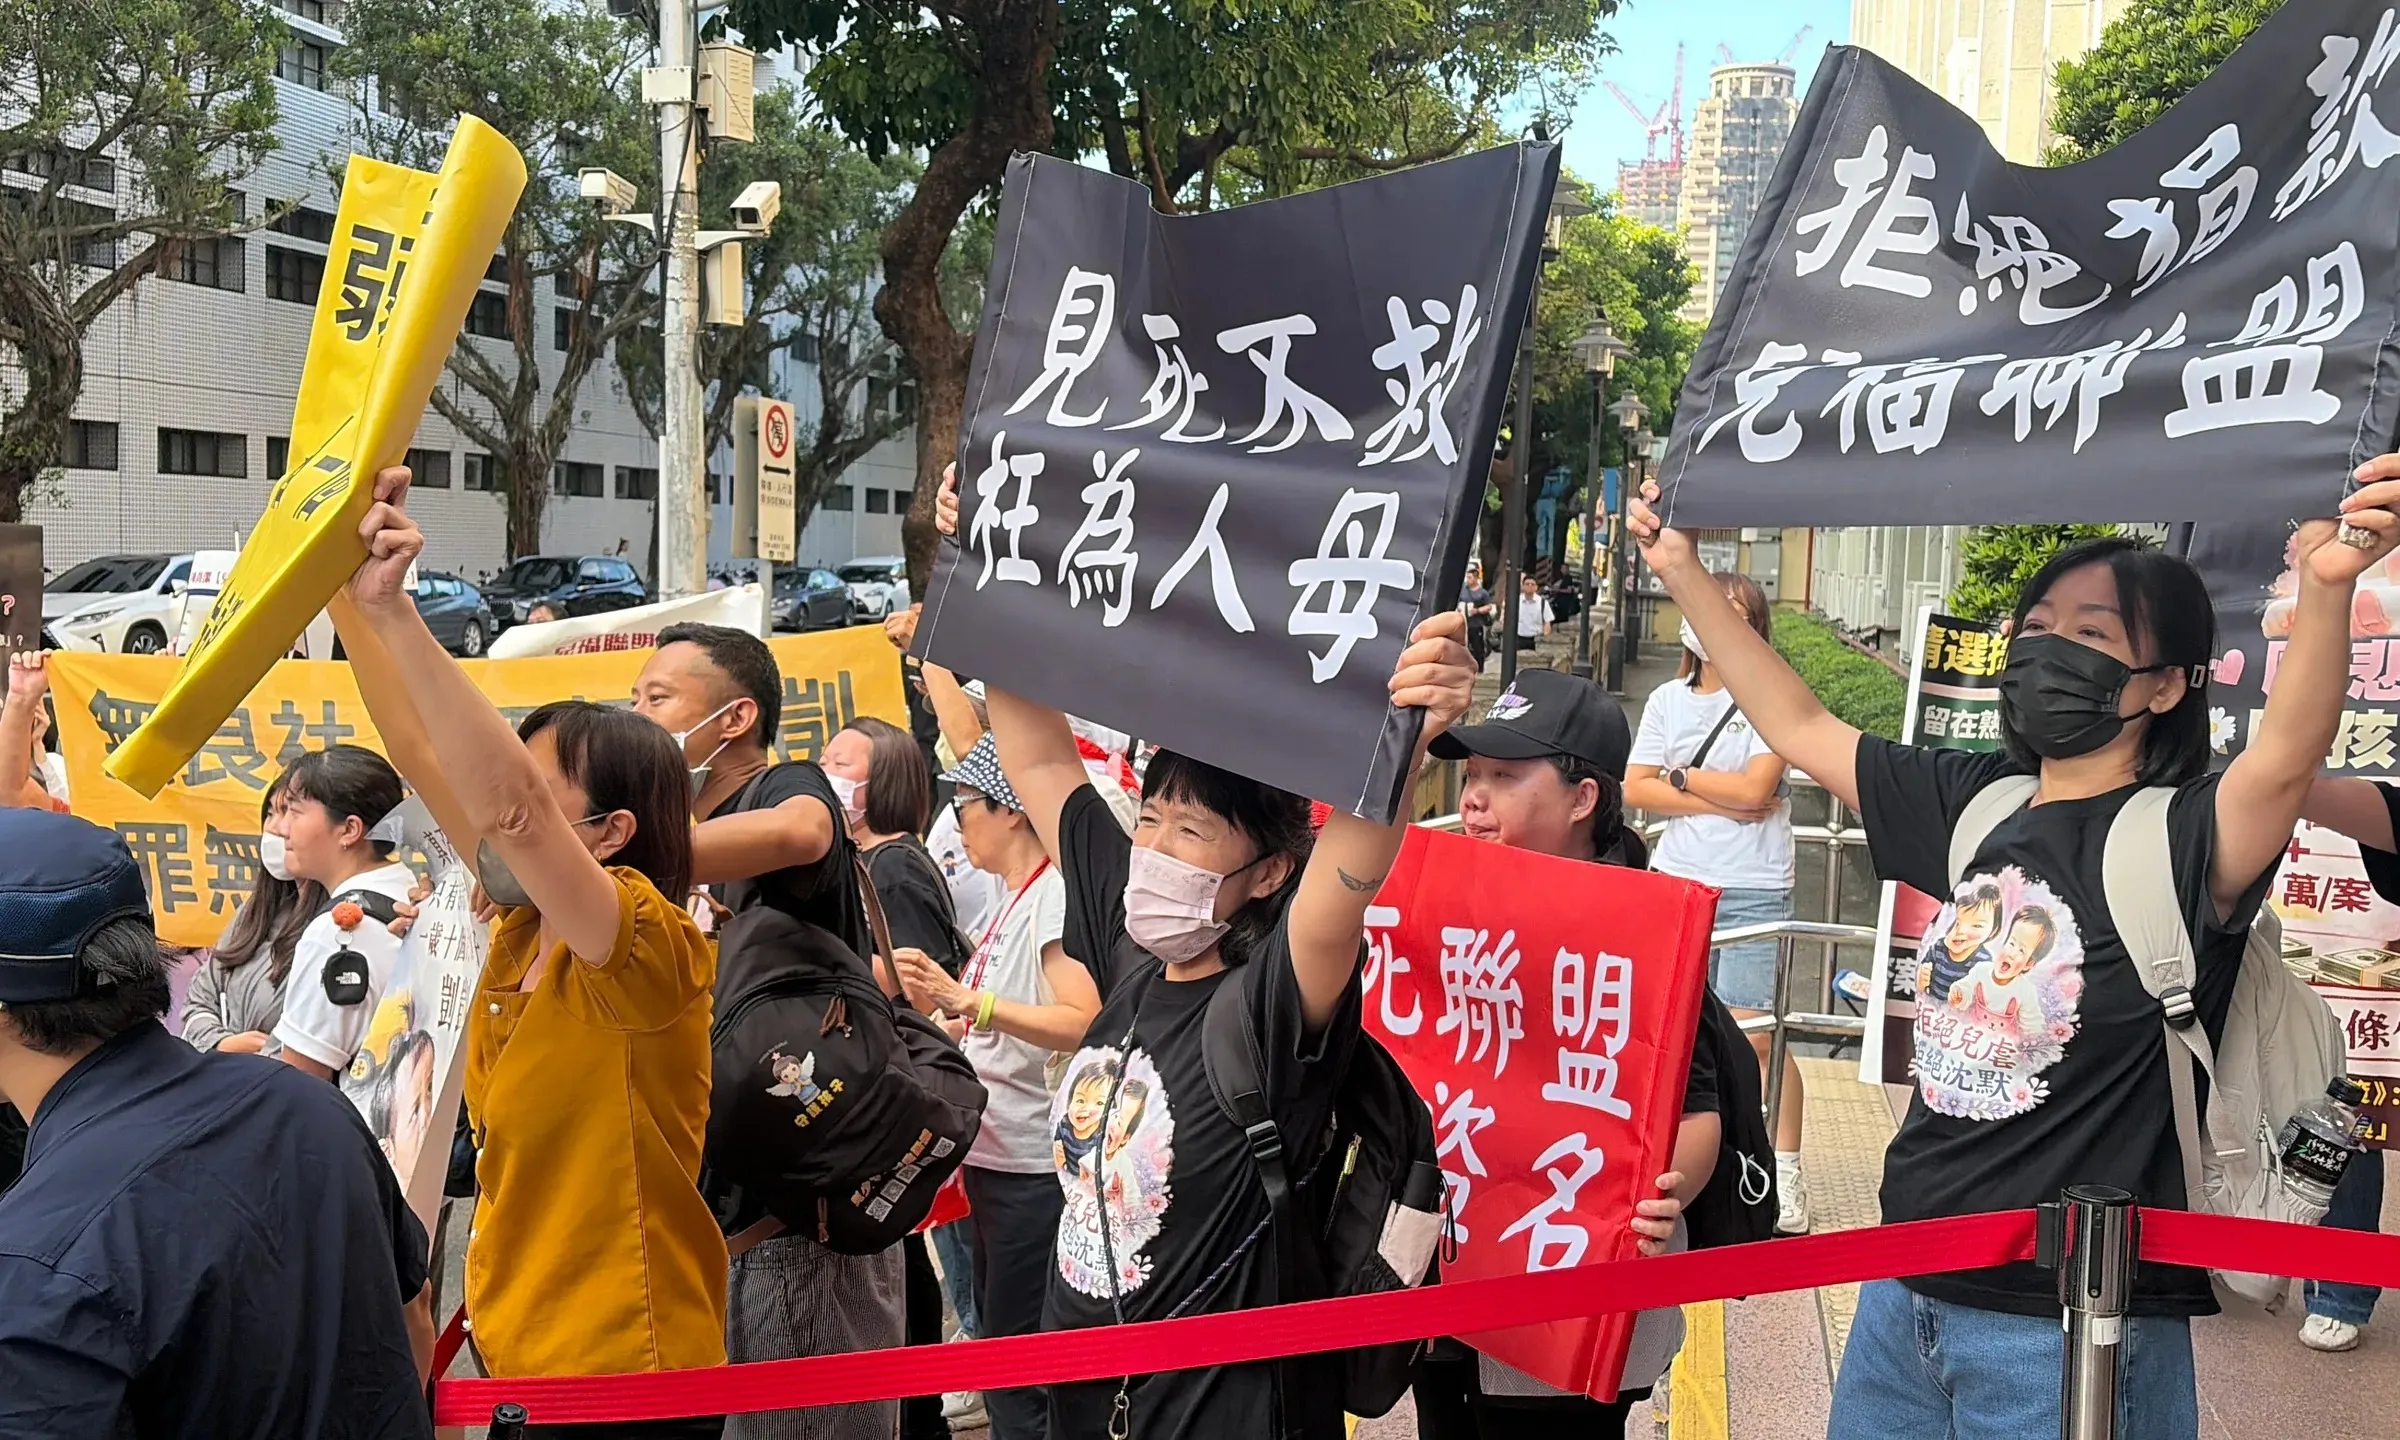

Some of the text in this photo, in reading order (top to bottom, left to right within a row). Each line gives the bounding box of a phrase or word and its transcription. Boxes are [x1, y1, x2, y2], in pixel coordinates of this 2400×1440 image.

[1004, 265, 1482, 466] 見死不救
[971, 430, 1415, 683] 枉為人母
[1916, 1001, 2017, 1070] 拒絕兒虐
